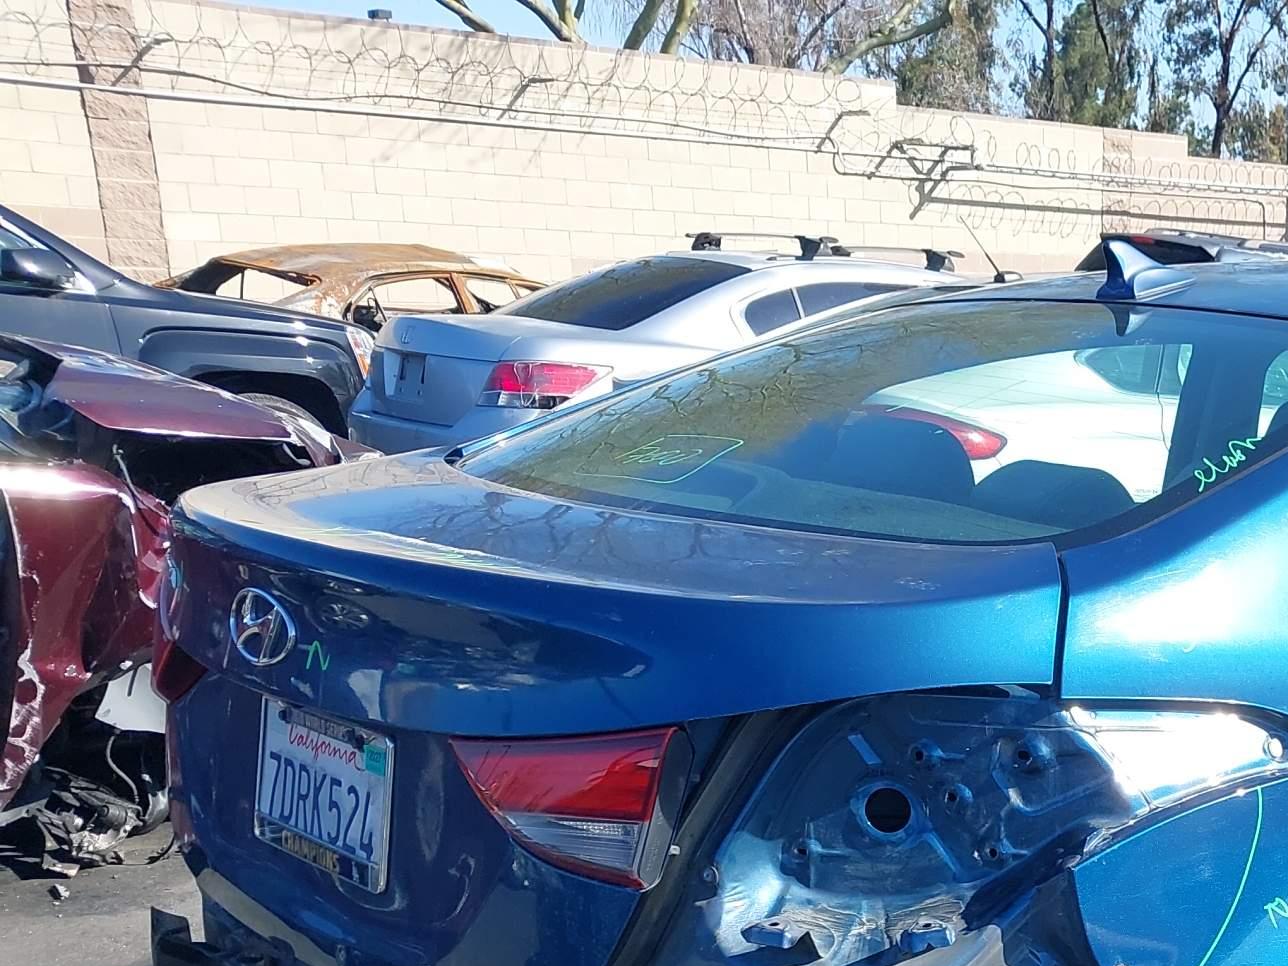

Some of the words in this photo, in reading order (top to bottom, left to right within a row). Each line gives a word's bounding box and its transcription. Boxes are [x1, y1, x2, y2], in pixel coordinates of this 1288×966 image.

[288, 723, 366, 771] California
[268, 751, 374, 862] 7DRK524
[281, 830, 340, 876] CHAMPIONS
